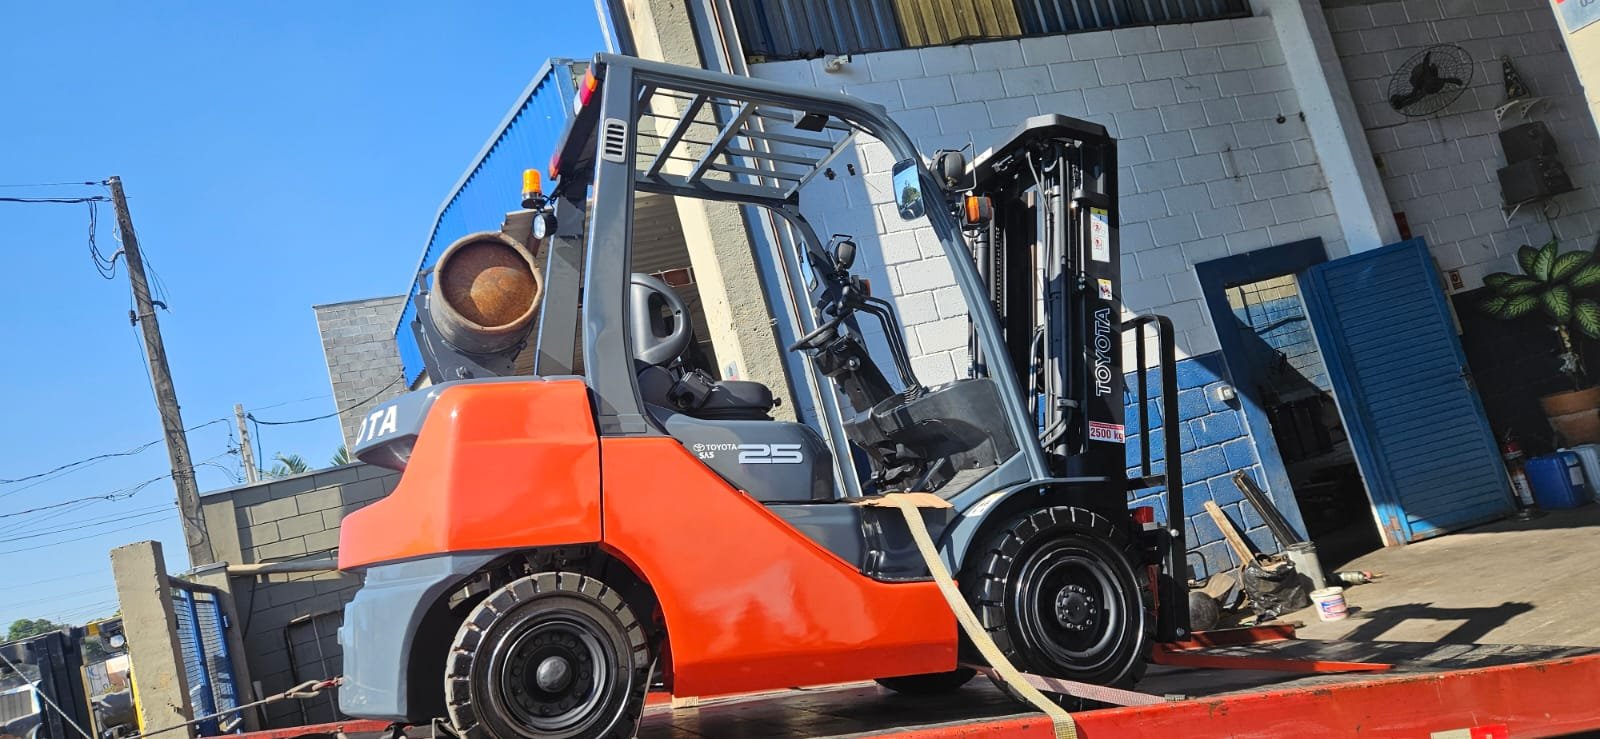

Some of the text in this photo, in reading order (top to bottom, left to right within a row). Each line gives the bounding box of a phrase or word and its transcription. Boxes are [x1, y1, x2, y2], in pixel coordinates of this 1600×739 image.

[1094, 307, 1112, 397] TOYOTA
[1090, 427, 1124, 443] 2500 kg
[699, 451, 715, 459] SAS
[706, 443, 738, 451] TOYOTA
[737, 443, 803, 464] 25
